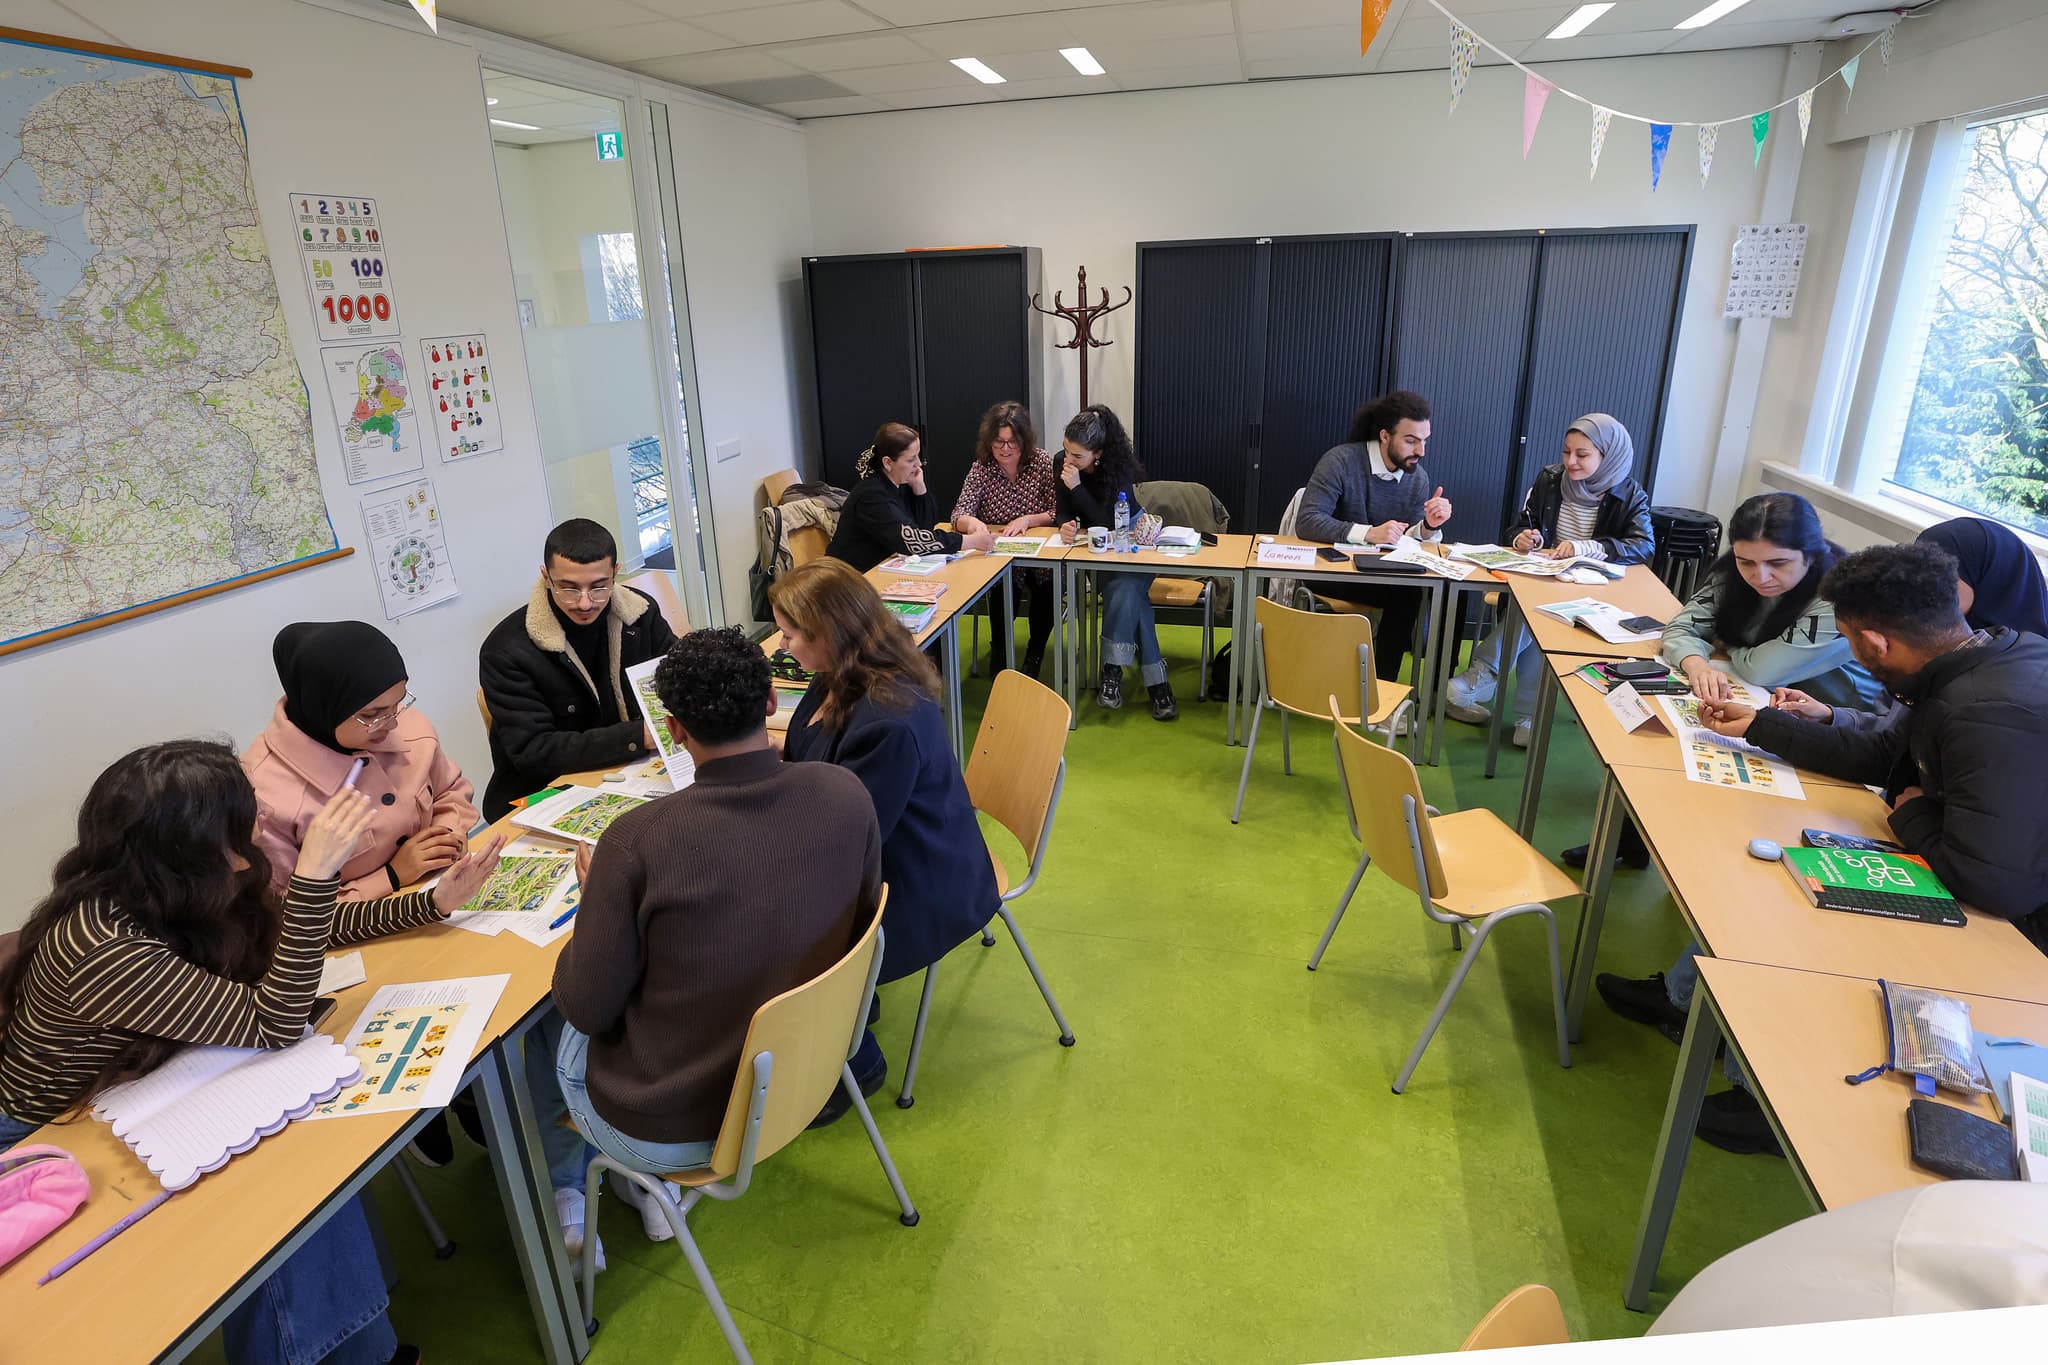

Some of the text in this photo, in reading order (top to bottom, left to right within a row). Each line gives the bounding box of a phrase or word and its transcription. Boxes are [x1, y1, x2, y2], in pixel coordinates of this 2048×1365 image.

[301, 200, 371, 216] 1 2 3 4 5
[302, 227, 379, 243] 6 7 8 9 10
[312, 258, 383, 278] 50 100
[322, 293, 391, 324] 1000
